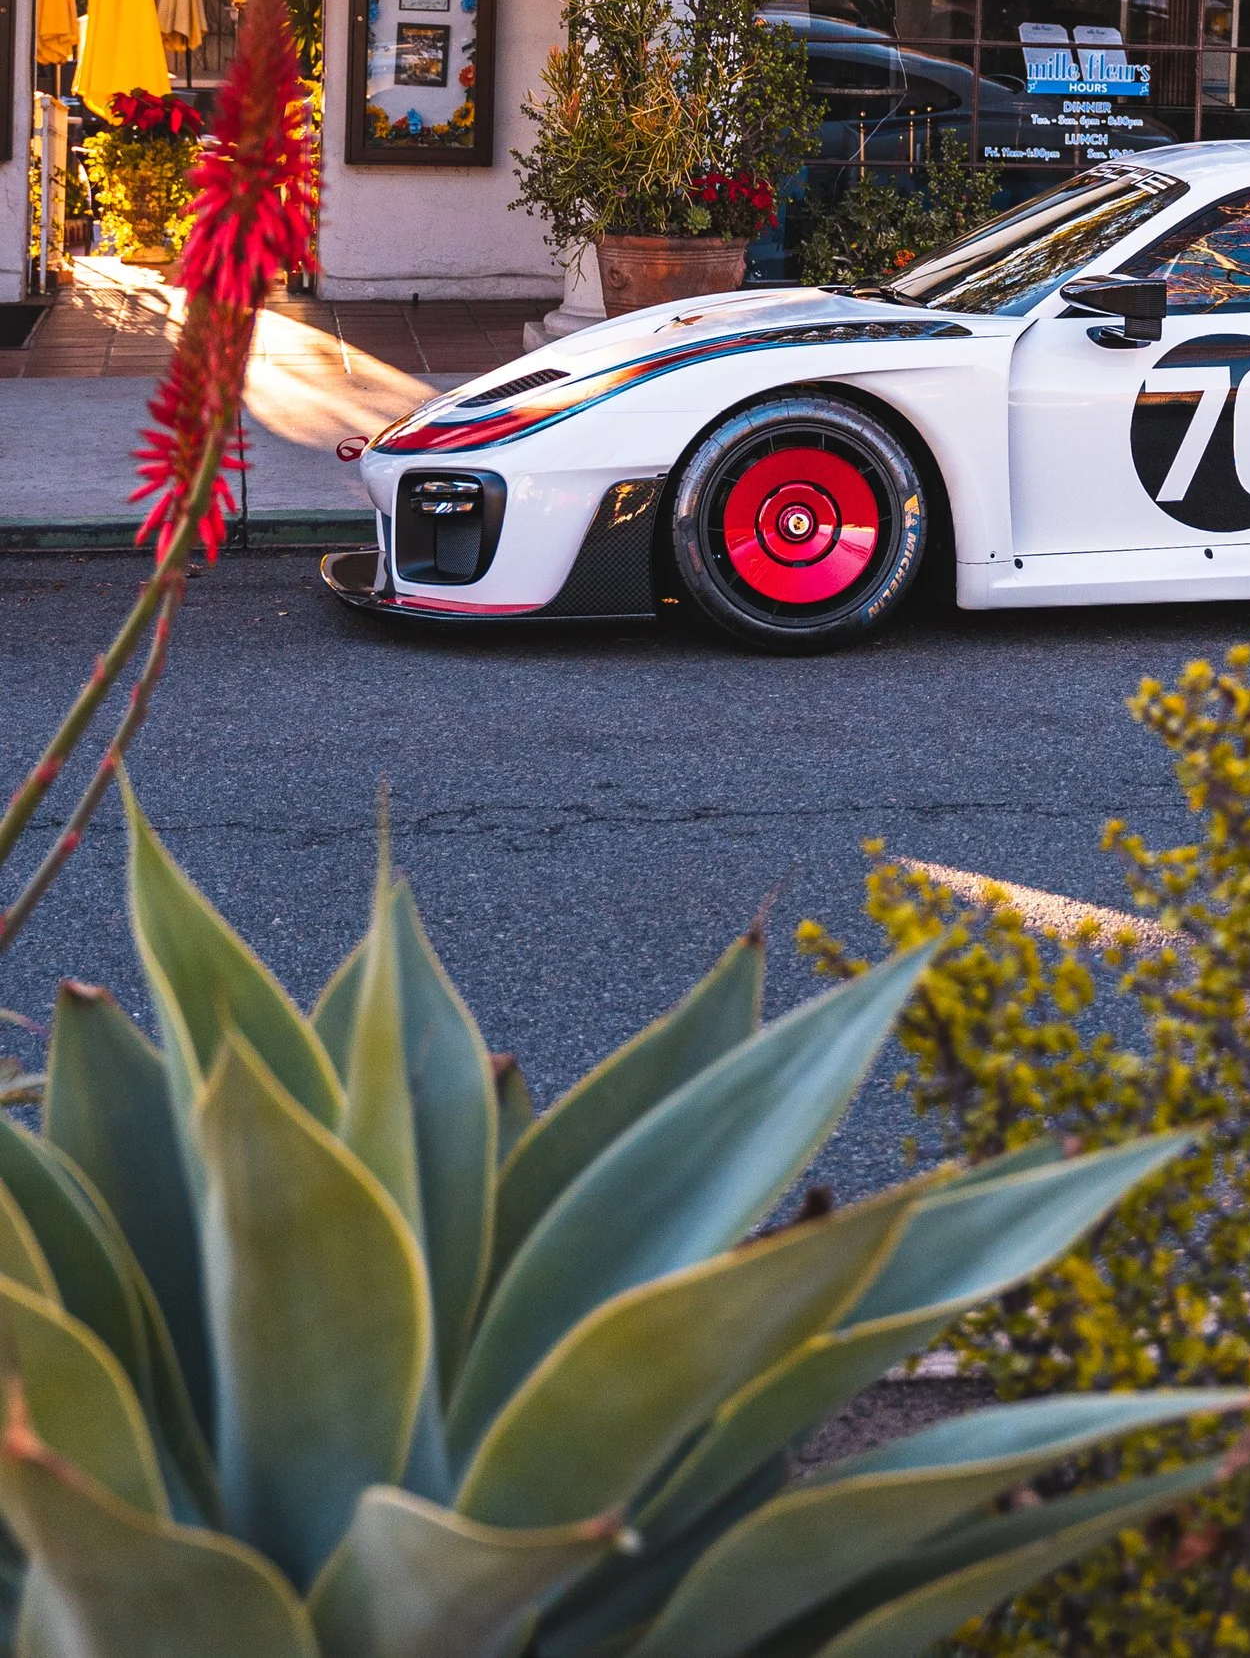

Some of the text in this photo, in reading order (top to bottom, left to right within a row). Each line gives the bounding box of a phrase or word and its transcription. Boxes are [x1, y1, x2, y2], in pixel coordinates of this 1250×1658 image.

[1027, 52, 1151, 83] mille fleurs
[1068, 82, 1108, 93] HOURS
[1063, 101, 1112, 114] DINNER
[1058, 114, 1079, 126] Sun.
[1065, 133, 1109, 146] LUNCH
[984, 146, 1001, 158] Fri.
[1087, 148, 1107, 159] Sun.
[867, 532, 917, 620] MICHELIN
